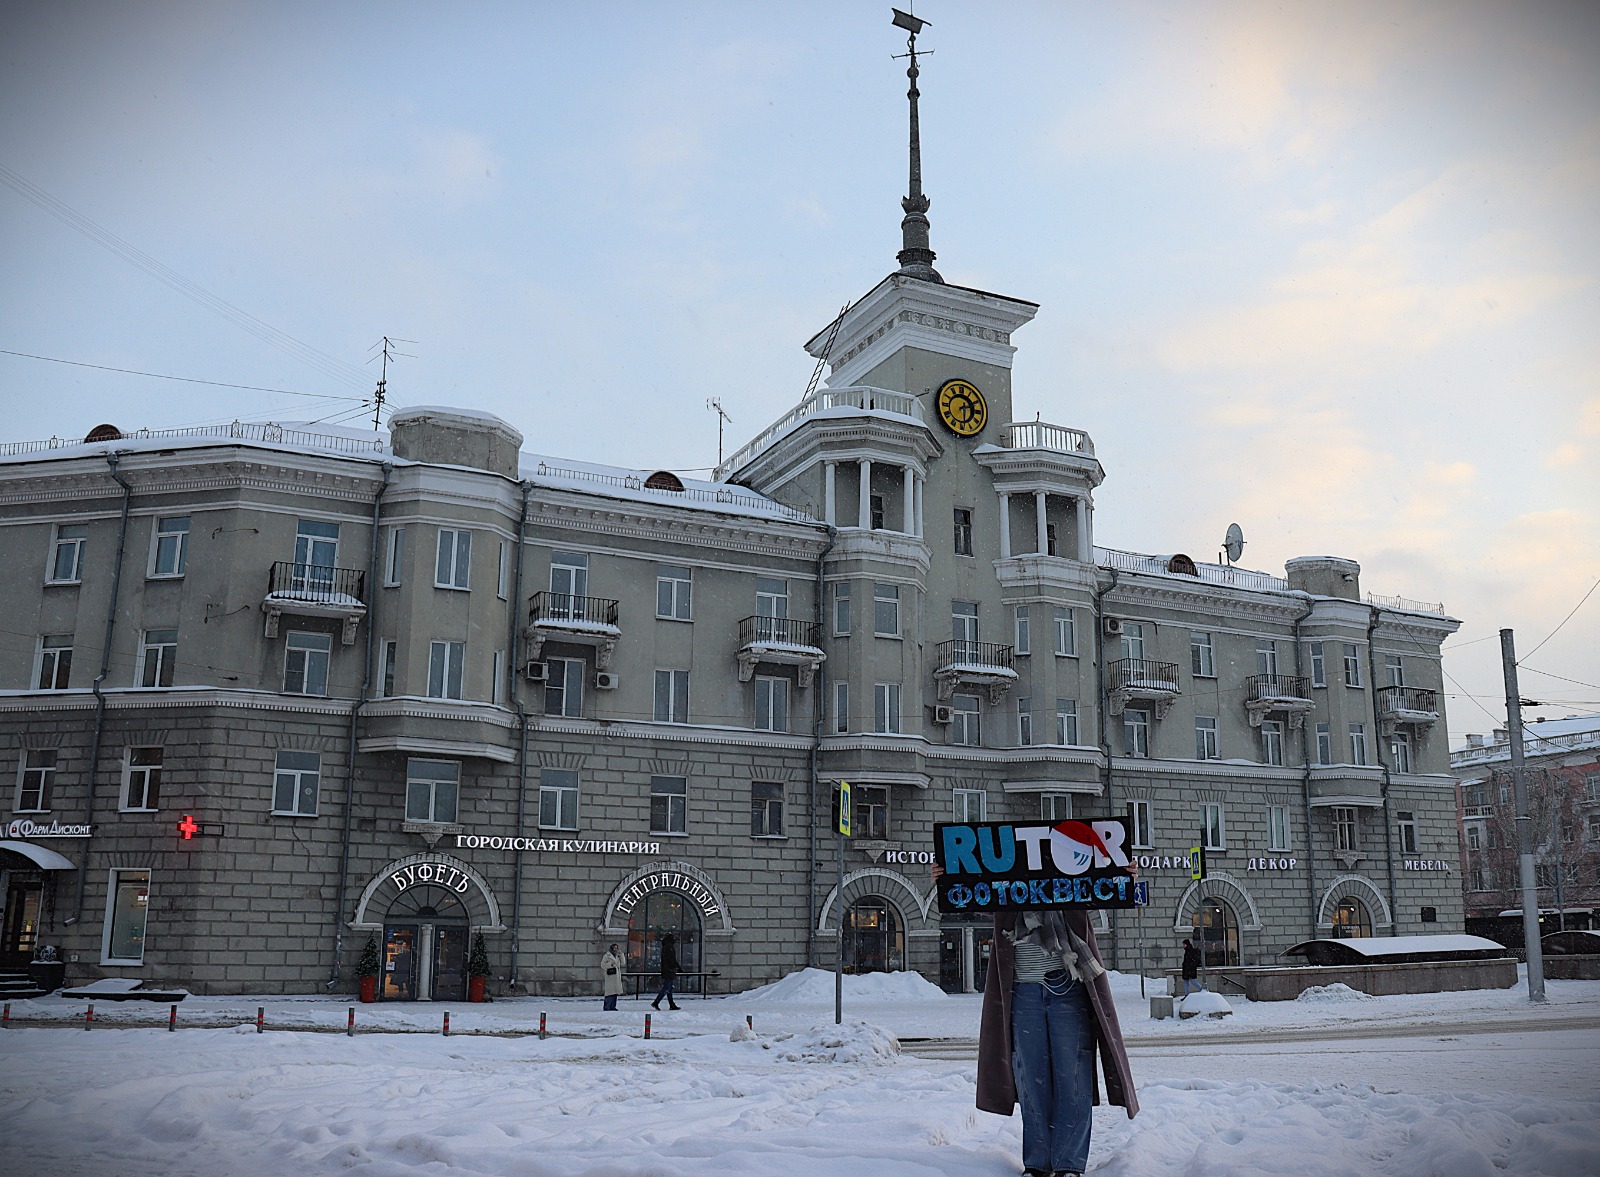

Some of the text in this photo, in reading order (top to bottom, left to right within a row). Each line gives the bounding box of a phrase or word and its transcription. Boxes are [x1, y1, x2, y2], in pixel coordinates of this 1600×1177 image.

[456, 835, 660, 854] ГОРОДСКАЯ КУЛИНАРИЯ
[942, 820, 1130, 875] RUTOR
[390, 863, 470, 893] БУФЕТЪ
[1247, 858, 1297, 872] ДЕКОР
[1404, 860, 1449, 871] МЕБЕЛЬ
[616, 872, 720, 917] ТЕАТРАЛЬНЫЙ
[947, 875, 1131, 909] ФОТОКВЕСТ
